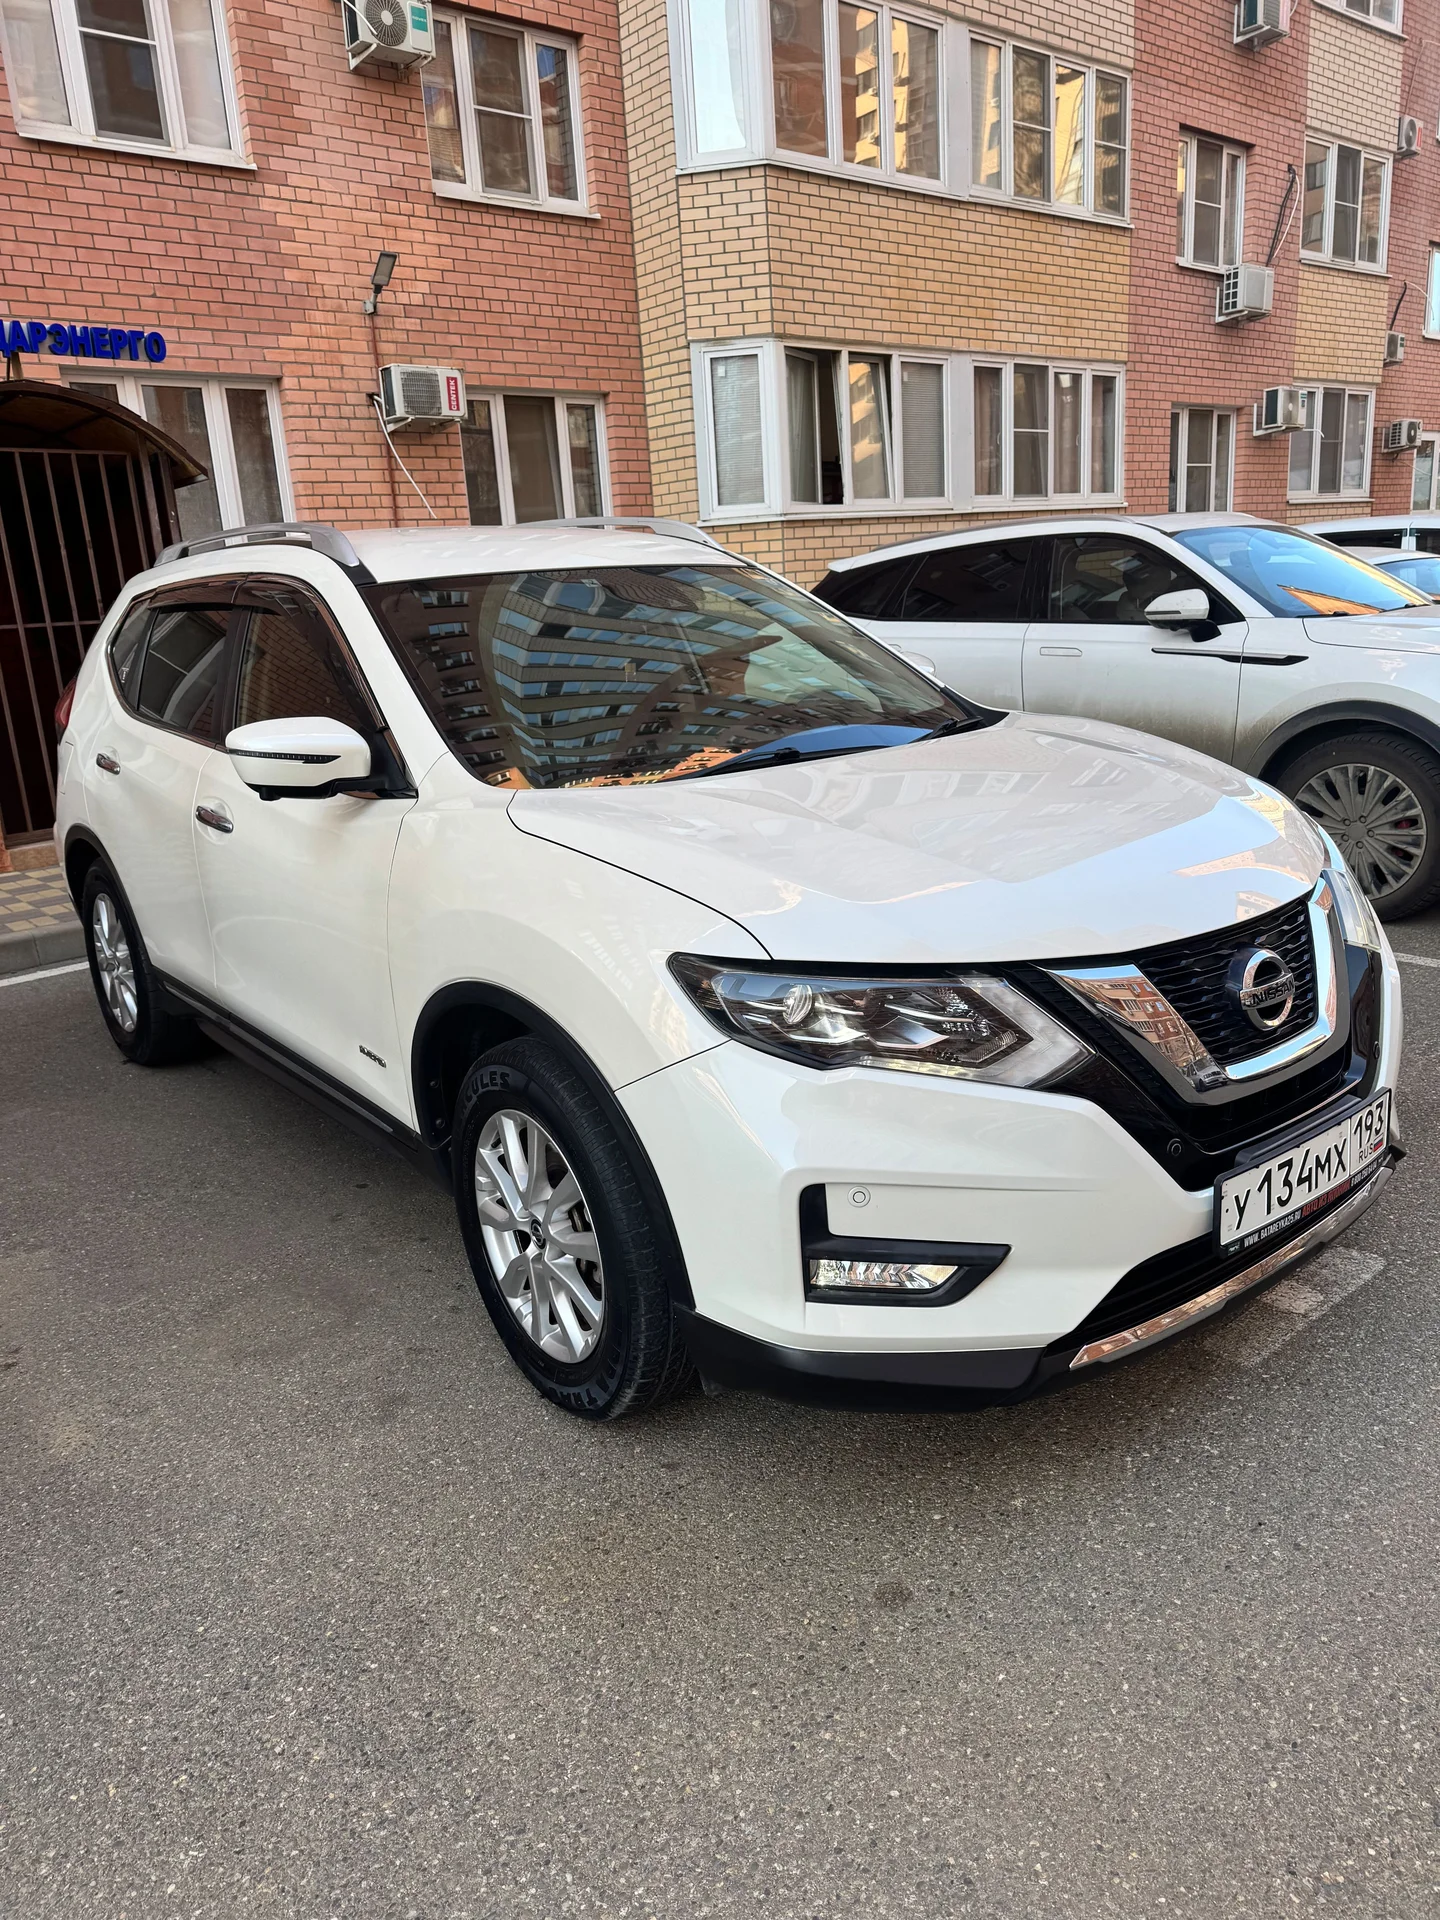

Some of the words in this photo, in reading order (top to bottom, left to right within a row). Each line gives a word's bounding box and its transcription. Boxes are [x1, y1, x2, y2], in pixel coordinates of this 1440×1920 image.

[449, 379, 457, 410] CENTEK
[1252, 980, 1295, 1004] NISSAN
[1353, 1100, 1384, 1149] 193
[1358, 1143, 1373, 1163] RUS
